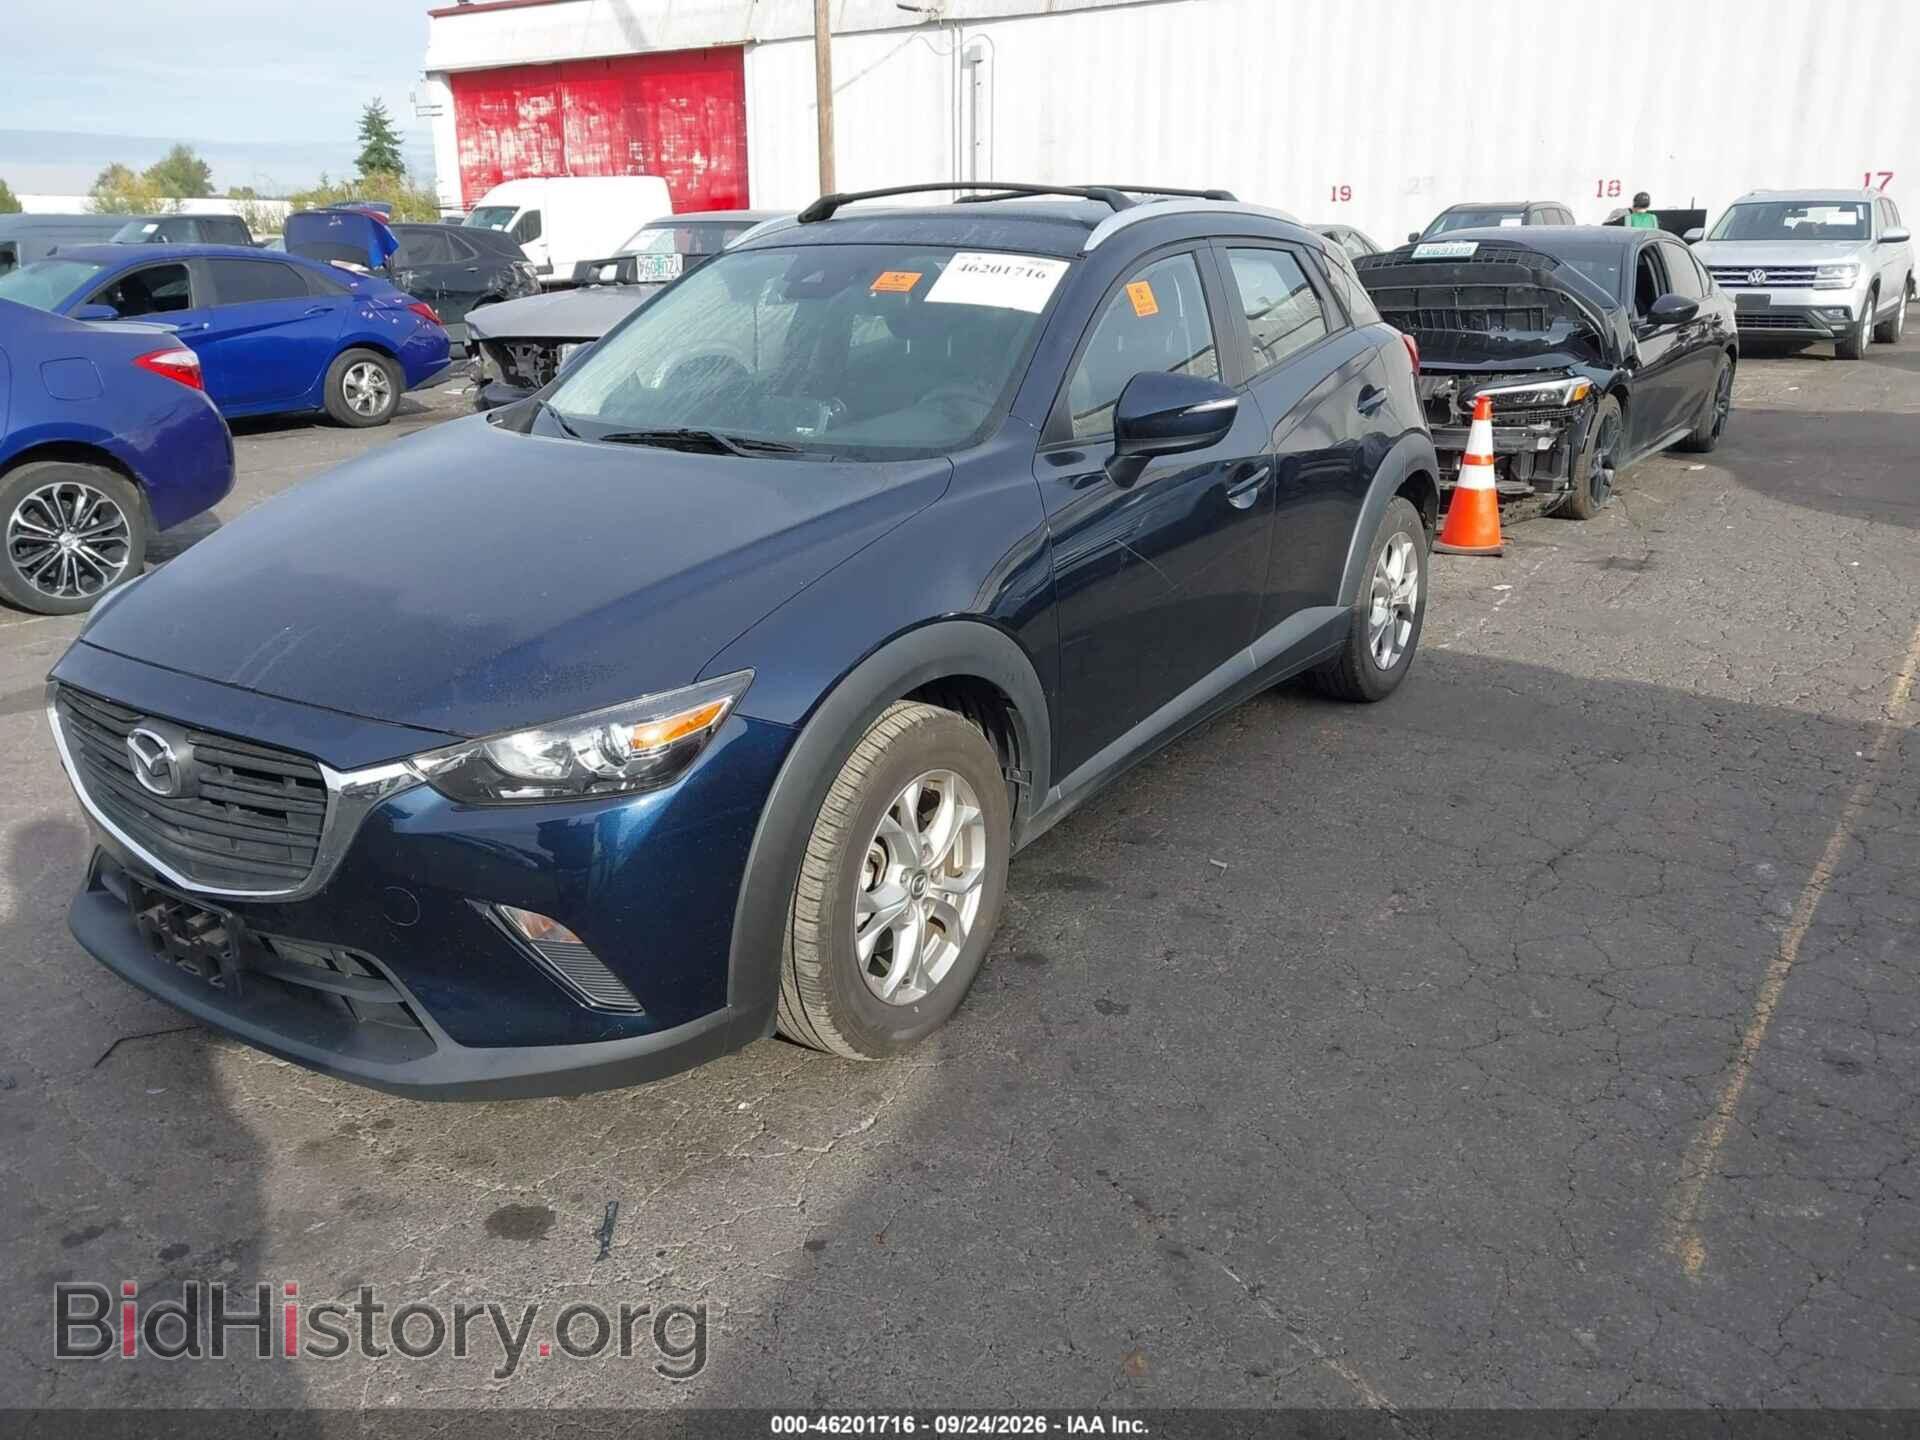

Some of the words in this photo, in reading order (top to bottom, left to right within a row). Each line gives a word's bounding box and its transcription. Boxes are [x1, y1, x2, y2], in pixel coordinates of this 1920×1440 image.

[1596, 179, 1621, 198] 18
[1863, 172, 1894, 192] 17
[1330, 185, 1351, 202] 19
[958, 263, 1047, 279] 46201716
